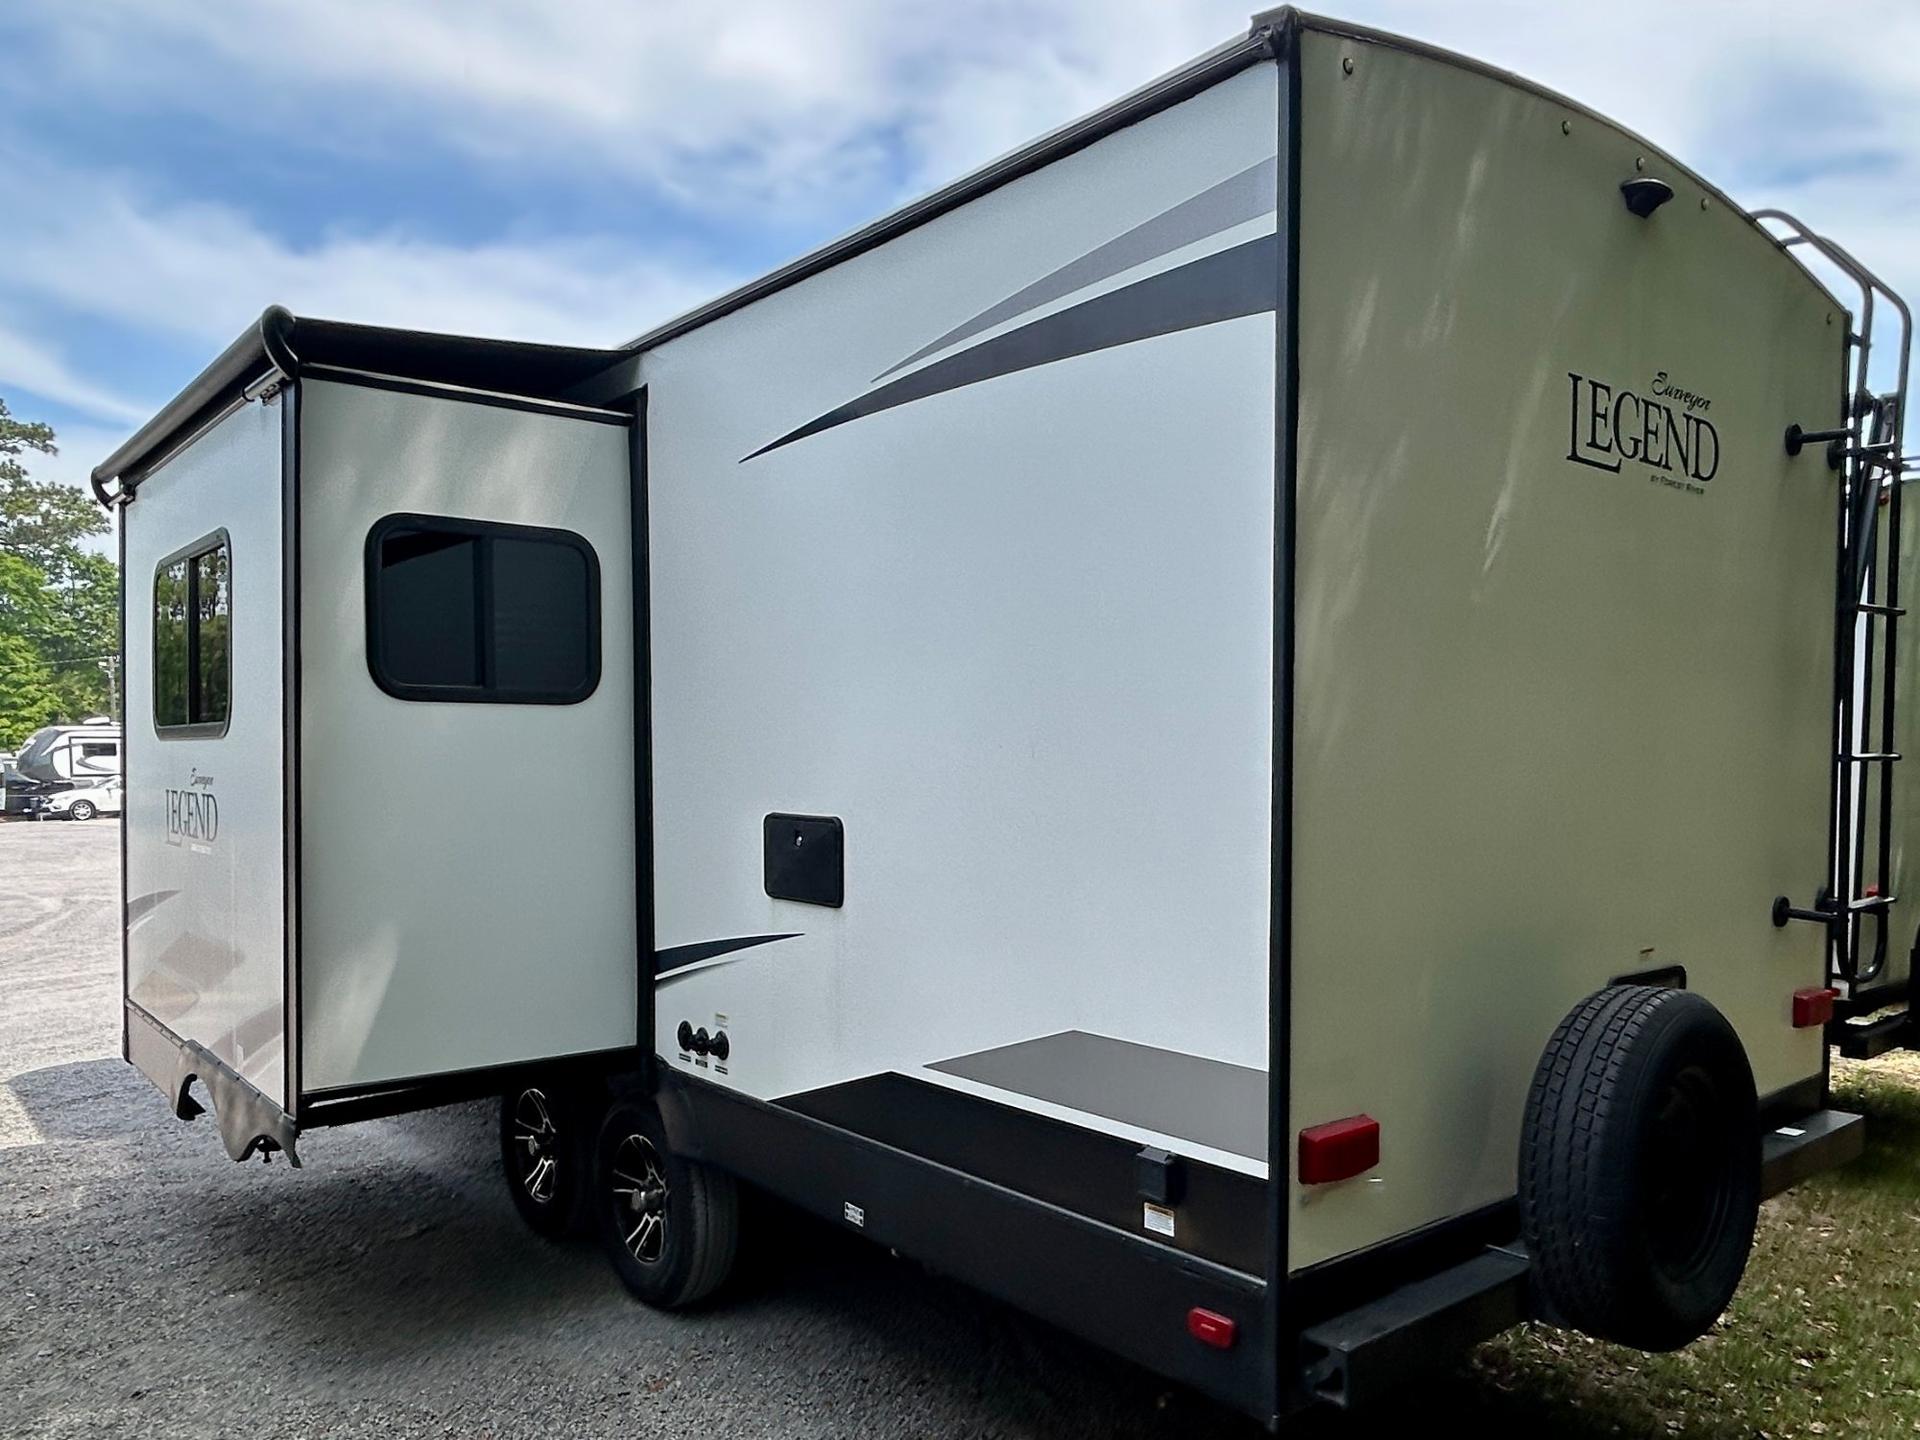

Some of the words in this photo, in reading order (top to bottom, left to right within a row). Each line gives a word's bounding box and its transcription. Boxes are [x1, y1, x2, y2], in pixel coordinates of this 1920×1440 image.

[1652, 371, 1711, 411] Surveyor
[1566, 372, 1720, 482] LEGEND
[165, 789, 219, 848] LEGEND
